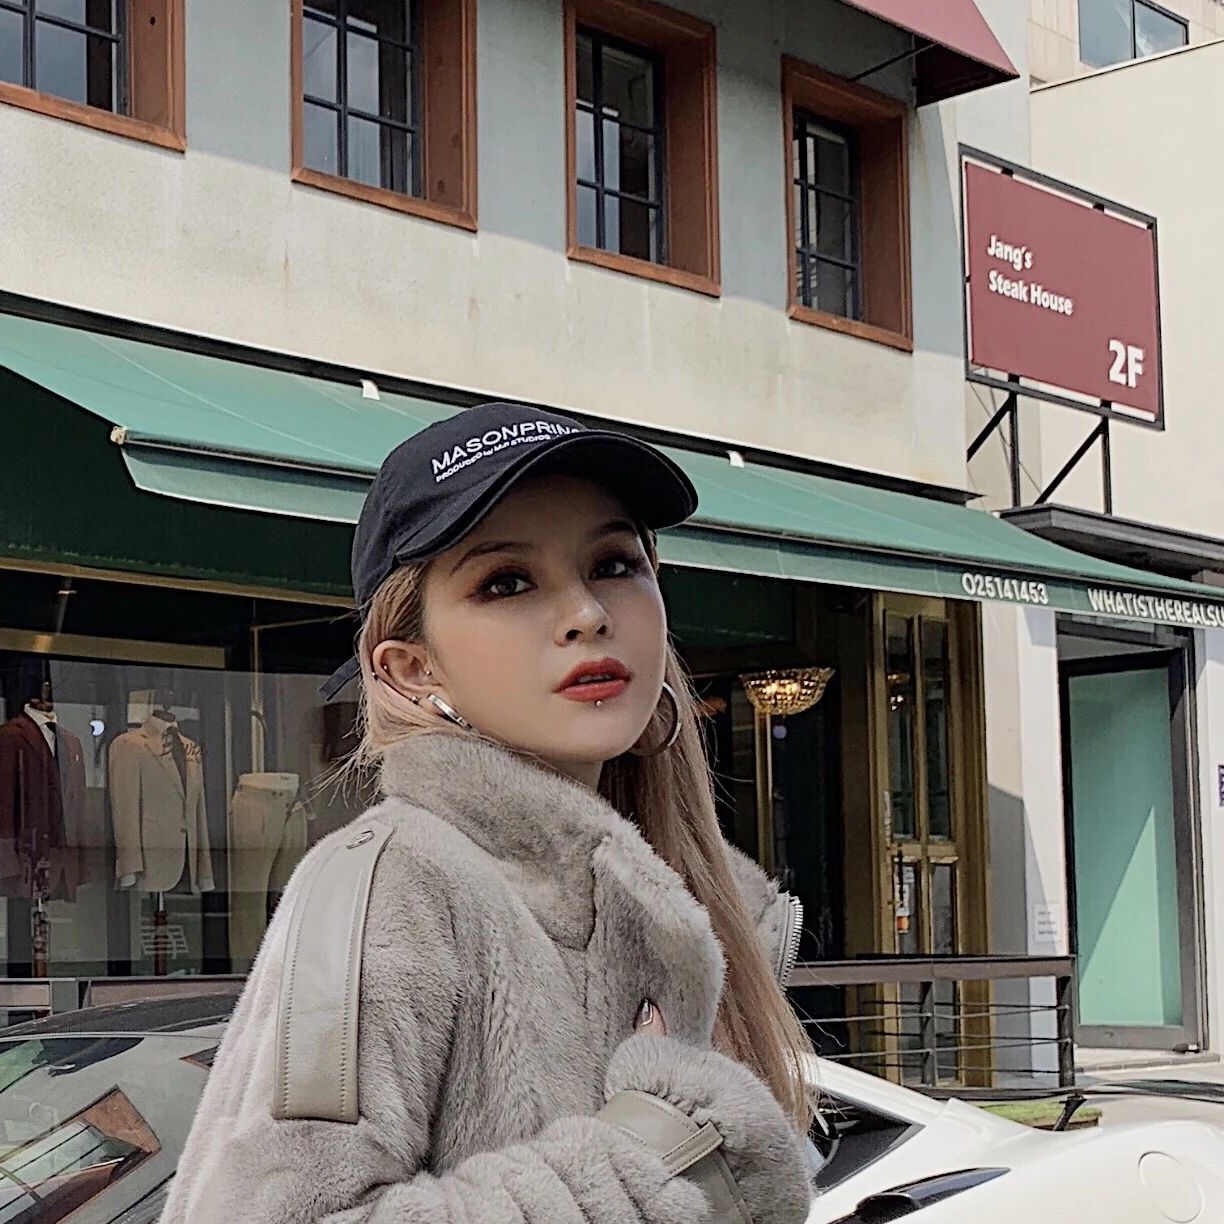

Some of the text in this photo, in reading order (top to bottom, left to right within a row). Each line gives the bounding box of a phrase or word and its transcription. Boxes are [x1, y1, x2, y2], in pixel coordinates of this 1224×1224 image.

[987, 235, 1033, 271] Jang's
[988, 269, 1074, 317] Steak House
[1108, 338, 1145, 388] 2F
[961, 572, 1049, 605] 025141453
